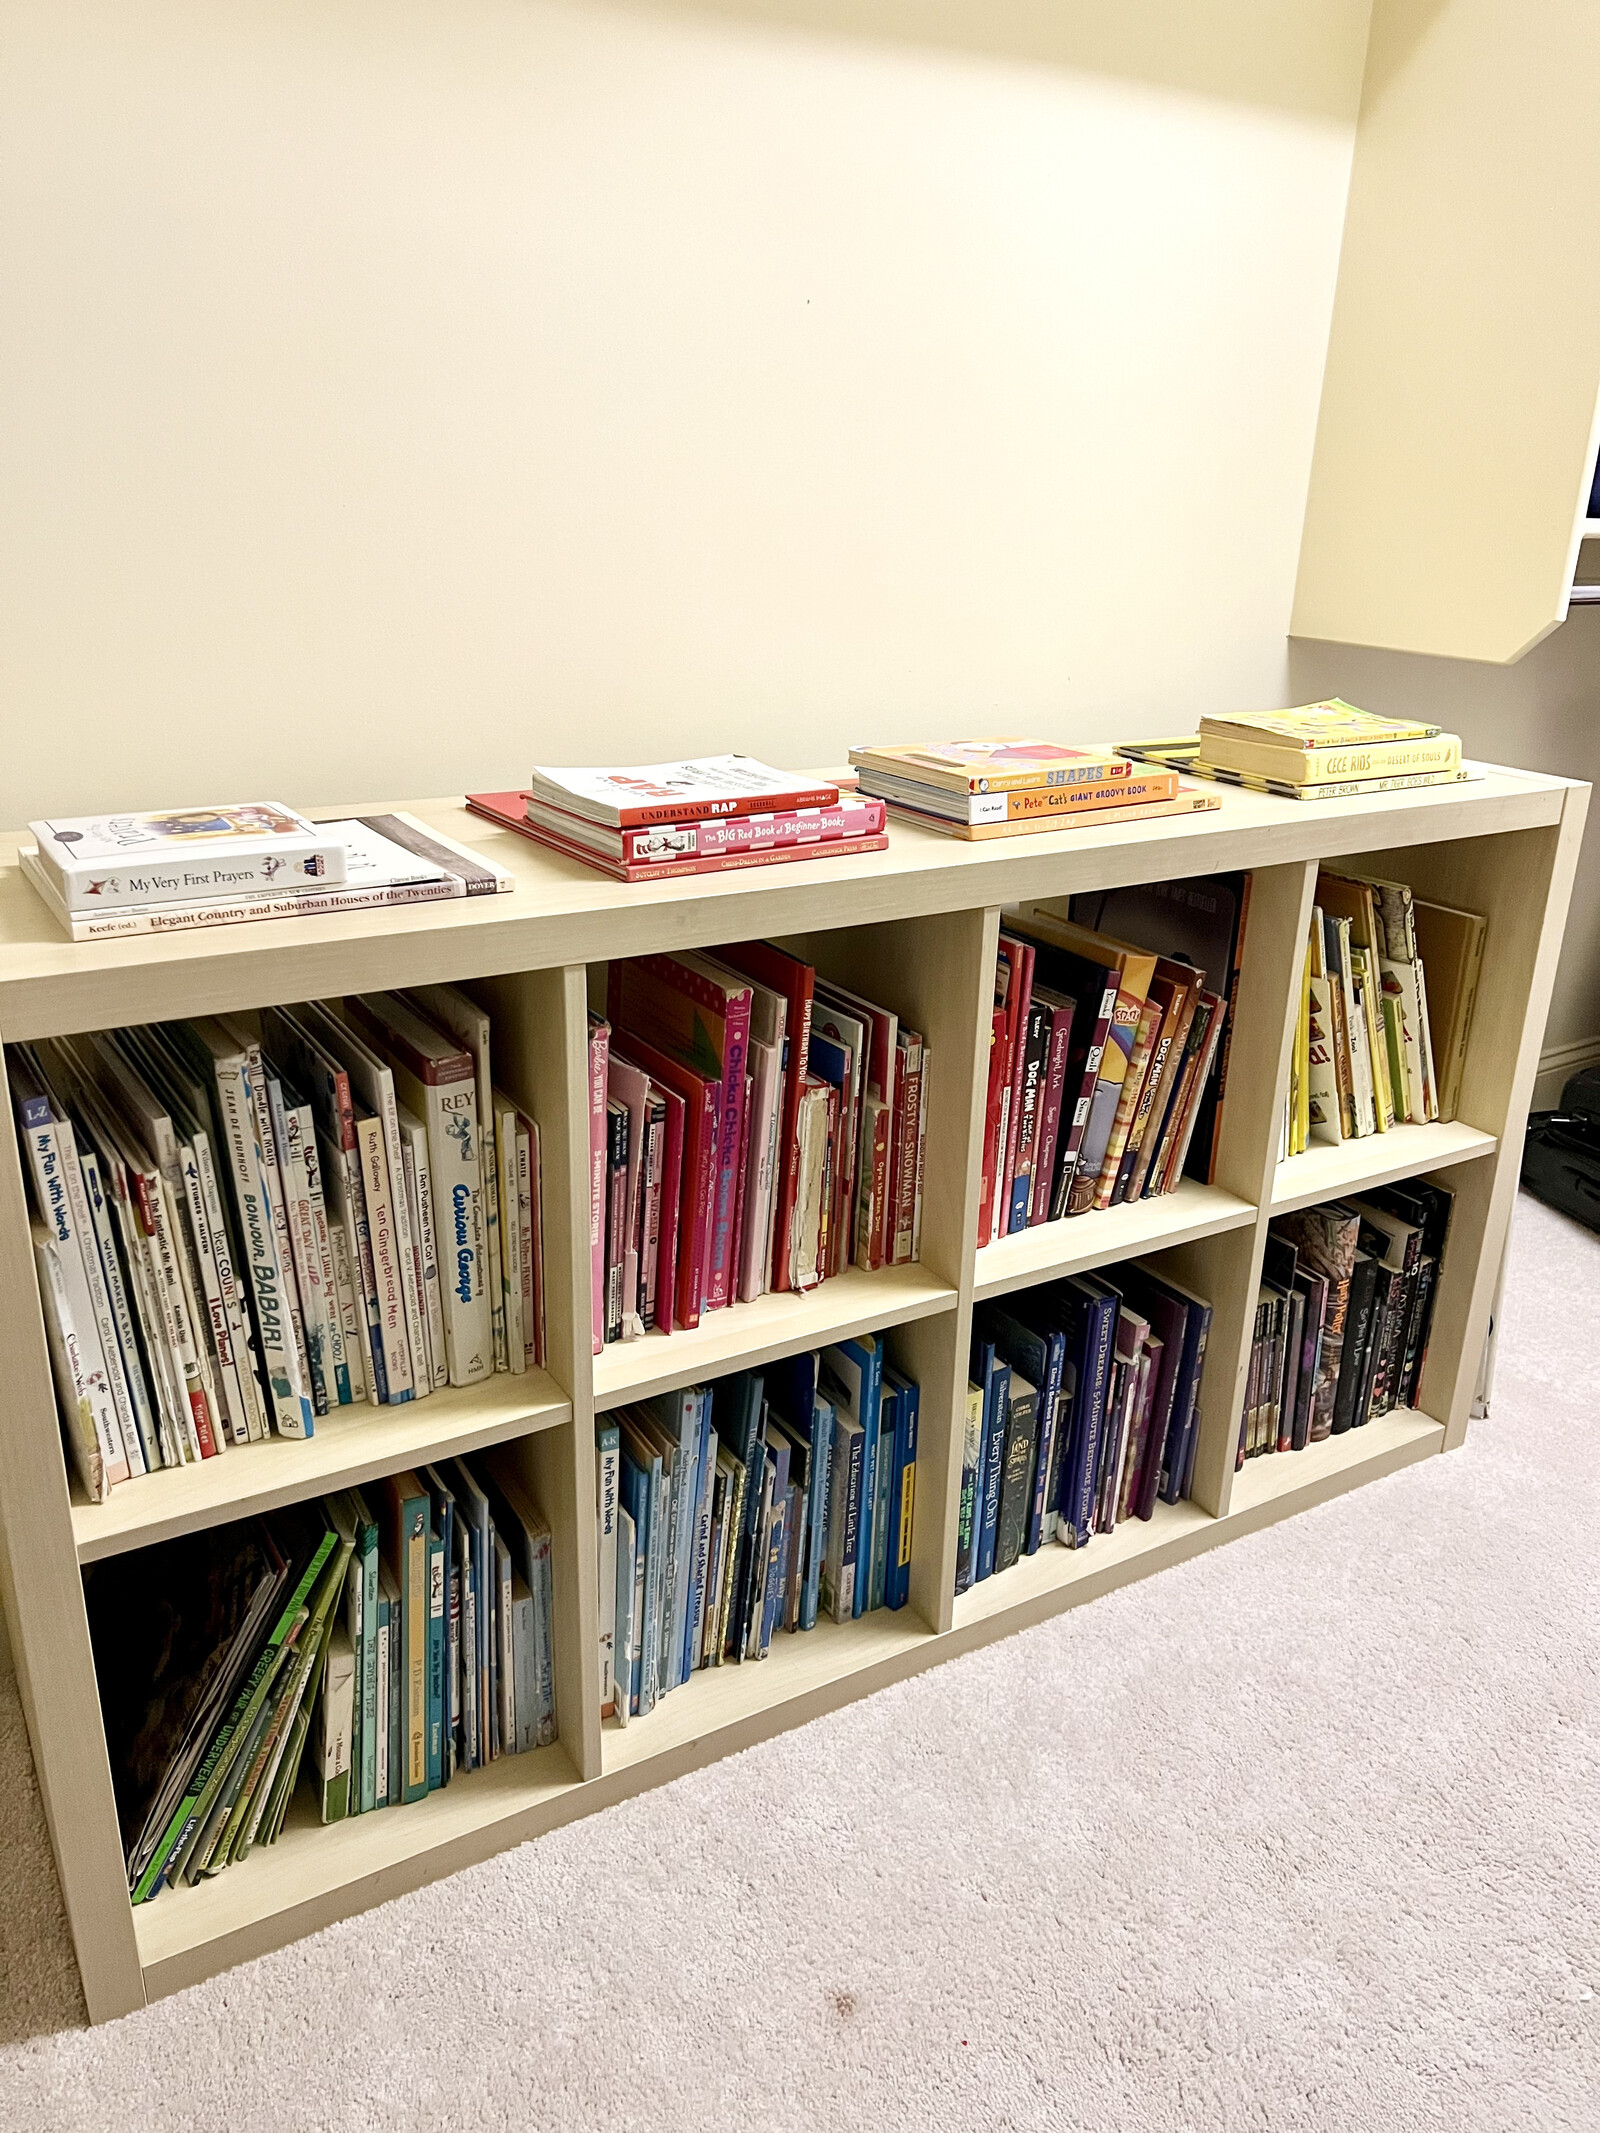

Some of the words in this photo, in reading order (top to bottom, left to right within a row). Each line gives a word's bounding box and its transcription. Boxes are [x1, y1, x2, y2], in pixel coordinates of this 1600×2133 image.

[1044, 764, 1104, 785] SHAPES
[1325, 756, 1346, 774] CECE
[1387, 753, 1410, 766] DESERT
[1411, 752, 1420, 763] OF
[1421, 749, 1440, 762] SOULS
[1023, 795, 1043, 810] Pete
[1047, 792, 1068, 806] Cat's
[1070, 791, 1093, 803] GIANT
[1094, 786, 1125, 800] GROOVY
[1126, 783, 1147, 795] BOOK
[640, 804, 709, 823] UNDERSTAND
[710, 800, 738, 814] RAP
[704, 833, 716, 843] The
[716, 828, 736, 843] BIG
[737, 828, 753, 840] Red
[754, 824, 775, 838] Book
[775, 825, 783, 835] of
[784, 817, 820, 836] Beginner
[819, 814, 845, 829] Books
[129, 877, 151, 895] My
[152, 874, 180, 892] Very
[183, 871, 209, 886] First
[213, 866, 254, 886] Prayers
[467, 879, 495, 893] DOVER
[150, 912, 196, 928] Elegant
[197, 907, 247, 922] Country
[249, 904, 271, 915] and
[273, 897, 328, 913] Suburban
[330, 892, 370, 906] Houses
[371, 890, 384, 901] of
[385, 888, 403, 900] the
[405, 883, 451, 898] Twenties
[803, 997, 812, 1020] HAPPY
[800, 1020, 810, 1055] BIRTHDAY
[1050, 1026, 1067, 1072] Goodnight
[1153, 1036, 1172, 1064] DOG
[591, 1037, 606, 1075] Barbie
[1085, 1045, 1102, 1071] Quilt
[593, 1074, 603, 1089] YOU
[723, 1043, 744, 1106] Chicka
[1025, 1059, 1039, 1087] DOG
[1051, 1071, 1061, 1089] Ark
[1147, 1062, 1164, 1087] MAN
[225, 1087, 237, 1114] JEAN
[253, 1083, 268, 1114] Doodle
[440, 1091, 475, 1113] REY
[593, 1088, 602, 1104] CAN
[593, 1103, 602, 1115] BE
[904, 1075, 919, 1128] FROSTY
[1023, 1087, 1035, 1112] MAN
[26, 1105, 48, 1121] L-Z
[230, 1116, 240, 1131] DE
[1074, 1098, 1088, 1123] States
[260, 1116, 271, 1135] with
[720, 1105, 738, 1166] Chicka
[905, 1127, 914, 1141] the
[36, 1133, 52, 1153] My
[262, 1137, 276, 1167] Maisy
[366, 1131, 378, 1153] Ruth
[791, 1142, 800, 1155] Dr.
[41, 1152, 57, 1175] Fun
[200, 1147, 212, 1173] Wilson
[233, 1132, 249, 1184] BRUNHOFF
[789, 1154, 799, 1176] Seuss
[369, 1154, 383, 1193] Galloway
[592, 1149, 601, 1200] 5-MINUTE
[899, 1140, 915, 1208] SNOWMAN
[47, 1175, 64, 1204] With
[204, 1179, 219, 1214] Chapman
[716, 1167, 733, 1218] Boom
[150, 1197, 161, 1213] The
[190, 1181, 202, 1215] STURGES
[197, 1222, 209, 1254] HALPERN
[375, 1204, 387, 1225] Ten
[451, 1182, 472, 1246] Curious
[52, 1204, 70, 1242] Words
[153, 1213, 169, 1251] Fantastic
[590, 1201, 600, 1246] STORIES
[212, 1229, 227, 1257] Bear
[711, 1220, 728, 1270] Boom
[161, 1251, 172, 1265] Mr.
[376, 1228, 397, 1302] Gingerbread
[164, 1265, 176, 1286] Wani
[218, 1258, 236, 1309] COUNTS
[452, 1246, 477, 1305] George
[103, 1237, 117, 1272] WHAT
[111, 1275, 125, 1309] MAKES
[121, 1322, 134, 1351] BABY
[1333, 1278, 1350, 1307] Harry
[172, 1304, 184, 1329] Kanako
[210, 1303, 226, 1329] Love
[250, 1260, 287, 1355] BABAR!
[386, 1304, 399, 1329] Men
[1330, 1304, 1346, 1336] Potter
[178, 1329, 188, 1344] Usui
[1099, 1306, 1112, 1342] SWEET
[214, 1329, 234, 1367] Planes!
[1094, 1342, 1108, 1389] DREAMS:
[995, 1379, 1008, 1423] Silverstein
[1088, 1390, 1102, 1440] 5-MINUTE
[98, 1407, 116, 1455] Southwestern
[604, 1455, 613, 1470] My
[851, 1443, 861, 1460] The
[1083, 1440, 1096, 1485] BEDTIME
[604, 1470, 613, 1486] Fun
[848, 1461, 860, 1500] Education
[604, 1486, 613, 1508] With
[848, 1501, 857, 1510] of
[986, 1498, 997, 1518] On
[603, 1507, 613, 1535] Words
[698, 1512, 710, 1541] Caring
[846, 1511, 856, 1534] Little
[985, 1518, 995, 1529] It
[698, 1540, 707, 1557] and
[846, 1535, 854, 1553] Tree
[367, 1570, 376, 1602] Silverstein
[694, 1557, 706, 1590] Sharing
[765, 1564, 778, 1601] DOGGIES
[691, 1590, 703, 1628] Treasury
[366, 1636, 375, 1655] THE
[245, 1648, 276, 1685] CREEPY
[366, 1657, 375, 1690] GIVING
[233, 1687, 255, 1709] PAIR
[365, 1693, 374, 1719] TREE
[228, 1711, 241, 1721] OF
[188, 1724, 235, 1791] UNDERWEAR!
[165, 1819, 197, 1862] Lift-the-Flap
